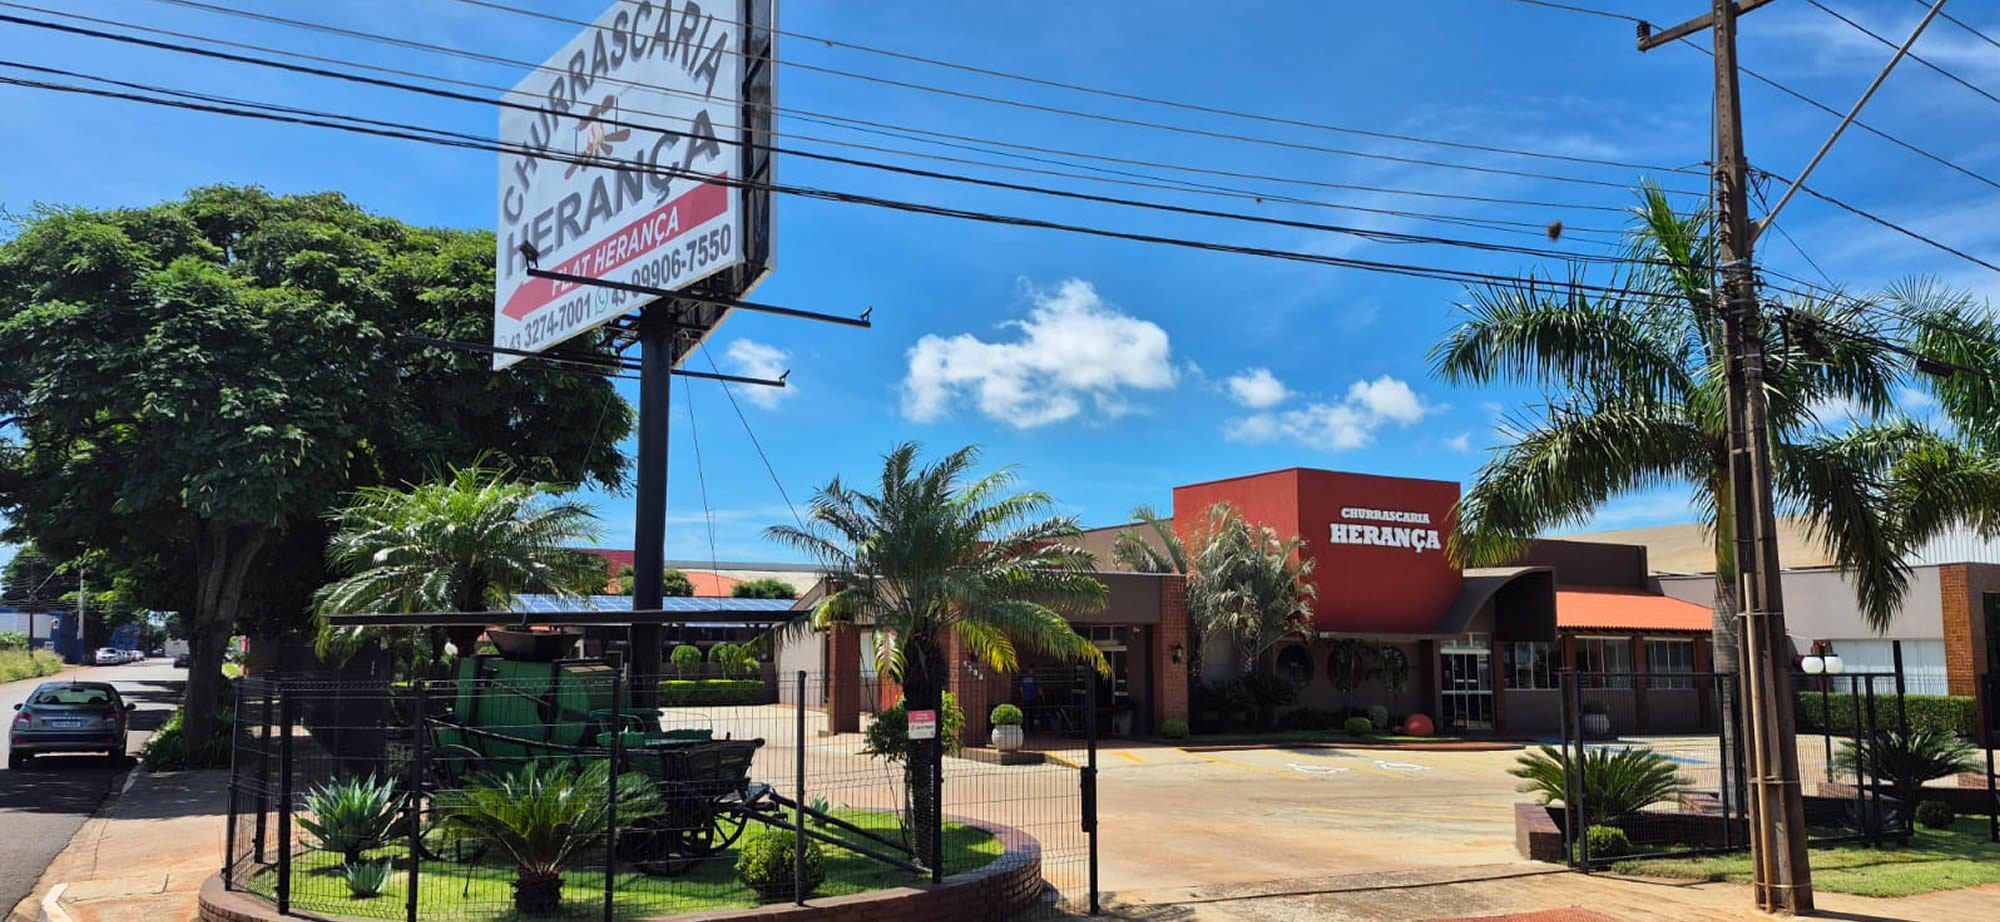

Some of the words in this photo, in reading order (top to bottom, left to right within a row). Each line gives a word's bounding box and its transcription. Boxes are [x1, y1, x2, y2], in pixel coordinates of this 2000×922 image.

[503, 0, 728, 225] CHURRASCARIA
[505, 109, 721, 281] HERANÇA
[524, 292, 592, 349] 3274-7001
[611, 281, 627, 307] 43
[631, 223, 731, 299] 99906-7550
[551, 253, 592, 297] FLAT
[593, 205, 679, 275] HERANÇA
[1330, 523, 1441, 553] HERANÇA
[1341, 507, 1430, 524] CHURRASCARIA
